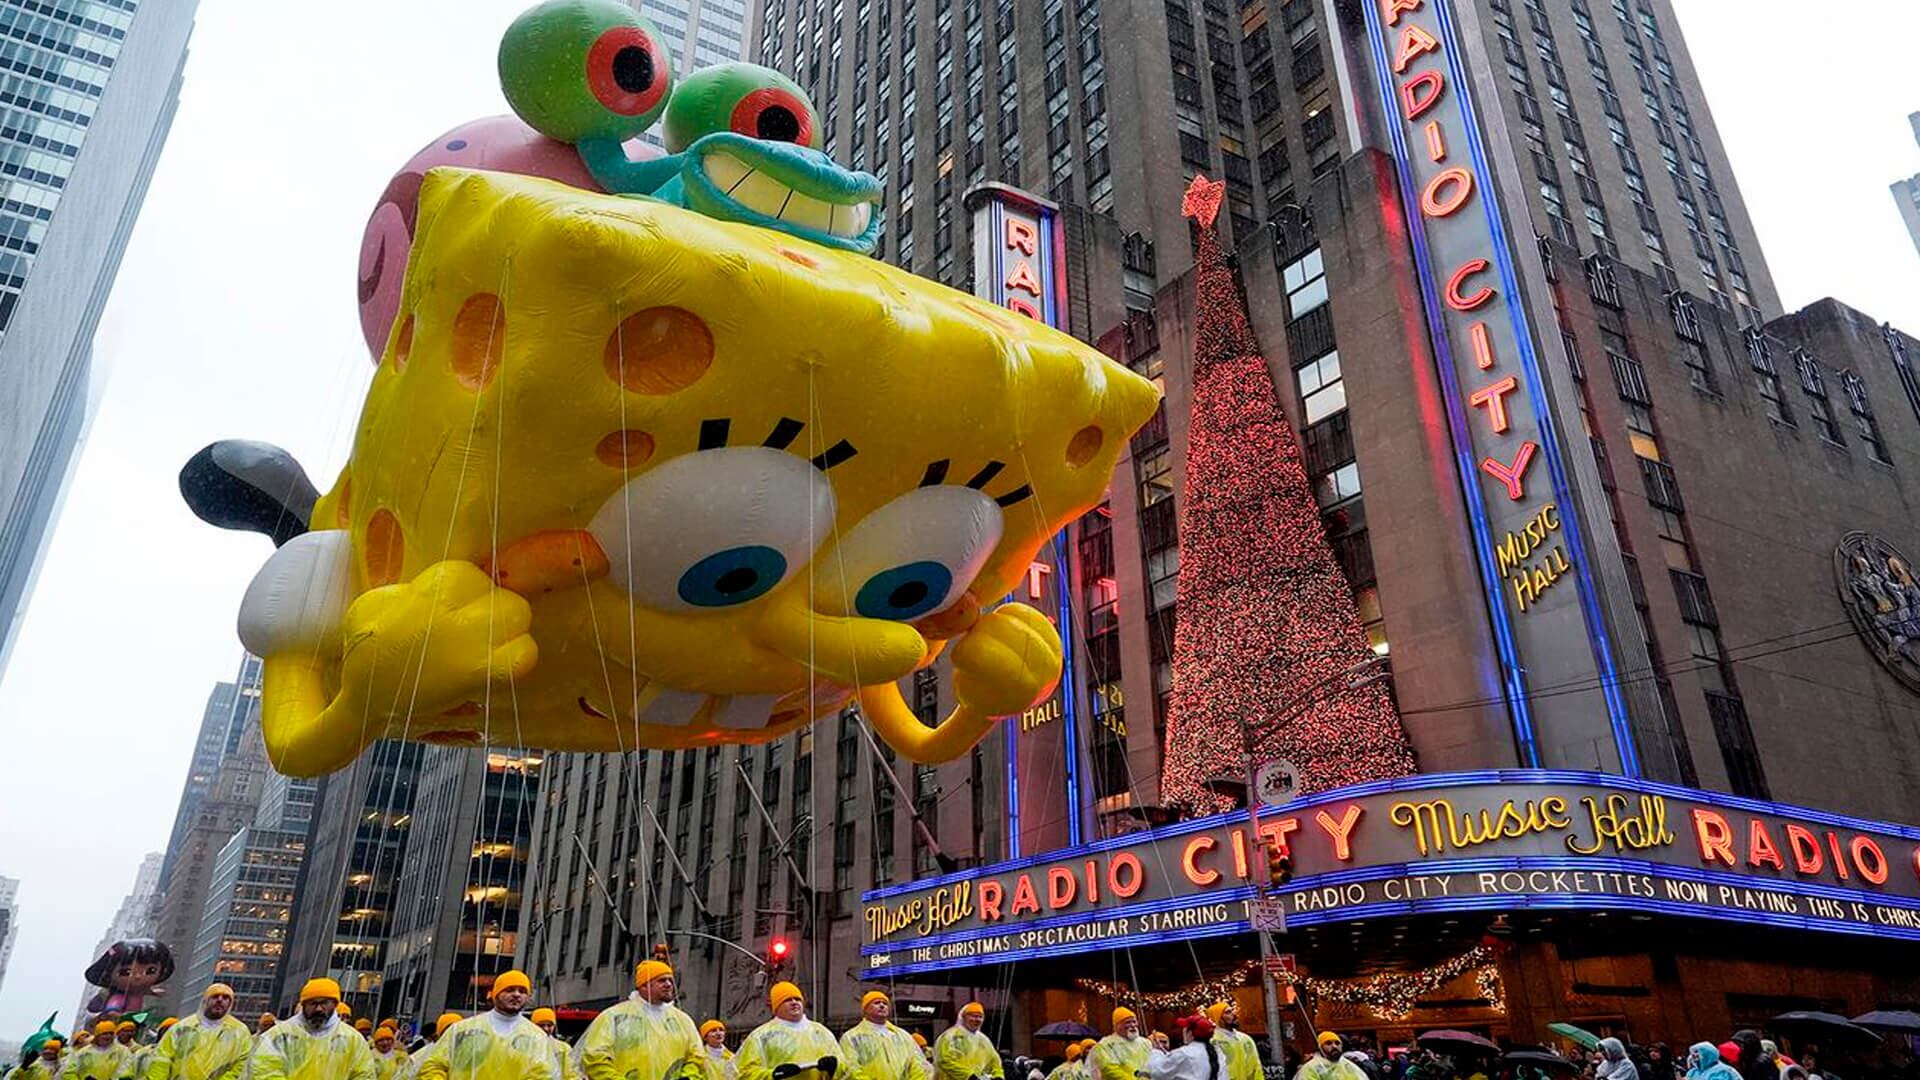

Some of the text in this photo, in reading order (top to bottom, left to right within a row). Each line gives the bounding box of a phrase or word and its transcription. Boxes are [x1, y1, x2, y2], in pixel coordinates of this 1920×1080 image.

[1445, 258, 1539, 500] CITY
[1497, 504, 1560, 578] MUSIC
[1513, 548, 1569, 613] HALL
[1022, 698, 1061, 732] HALL
[865, 899, 922, 942] Music
[917, 879, 973, 936] Hall
[979, 851, 1144, 921] RADIO
[1183, 803, 1362, 886] CITY
[1390, 797, 1572, 857] Music
[1566, 792, 1675, 854] Hall
[1691, 807, 1889, 886] RADIO
[912, 946, 934, 962] THE
[940, 934, 1010, 959] CHRISTMAS
[1019, 918, 1130, 949] SPECTACULAR
[1140, 902, 1229, 933] STARRING
[1293, 883, 1366, 912] RADIO
[1383, 874, 1451, 900] CITY
[1478, 870, 1655, 897] ROCKETTES
[1664, 878, 1709, 903] NOW
[1718, 885, 1798, 914] PLAYING
[1805, 895, 1846, 919] THIS
[1850, 902, 1870, 922] IS
